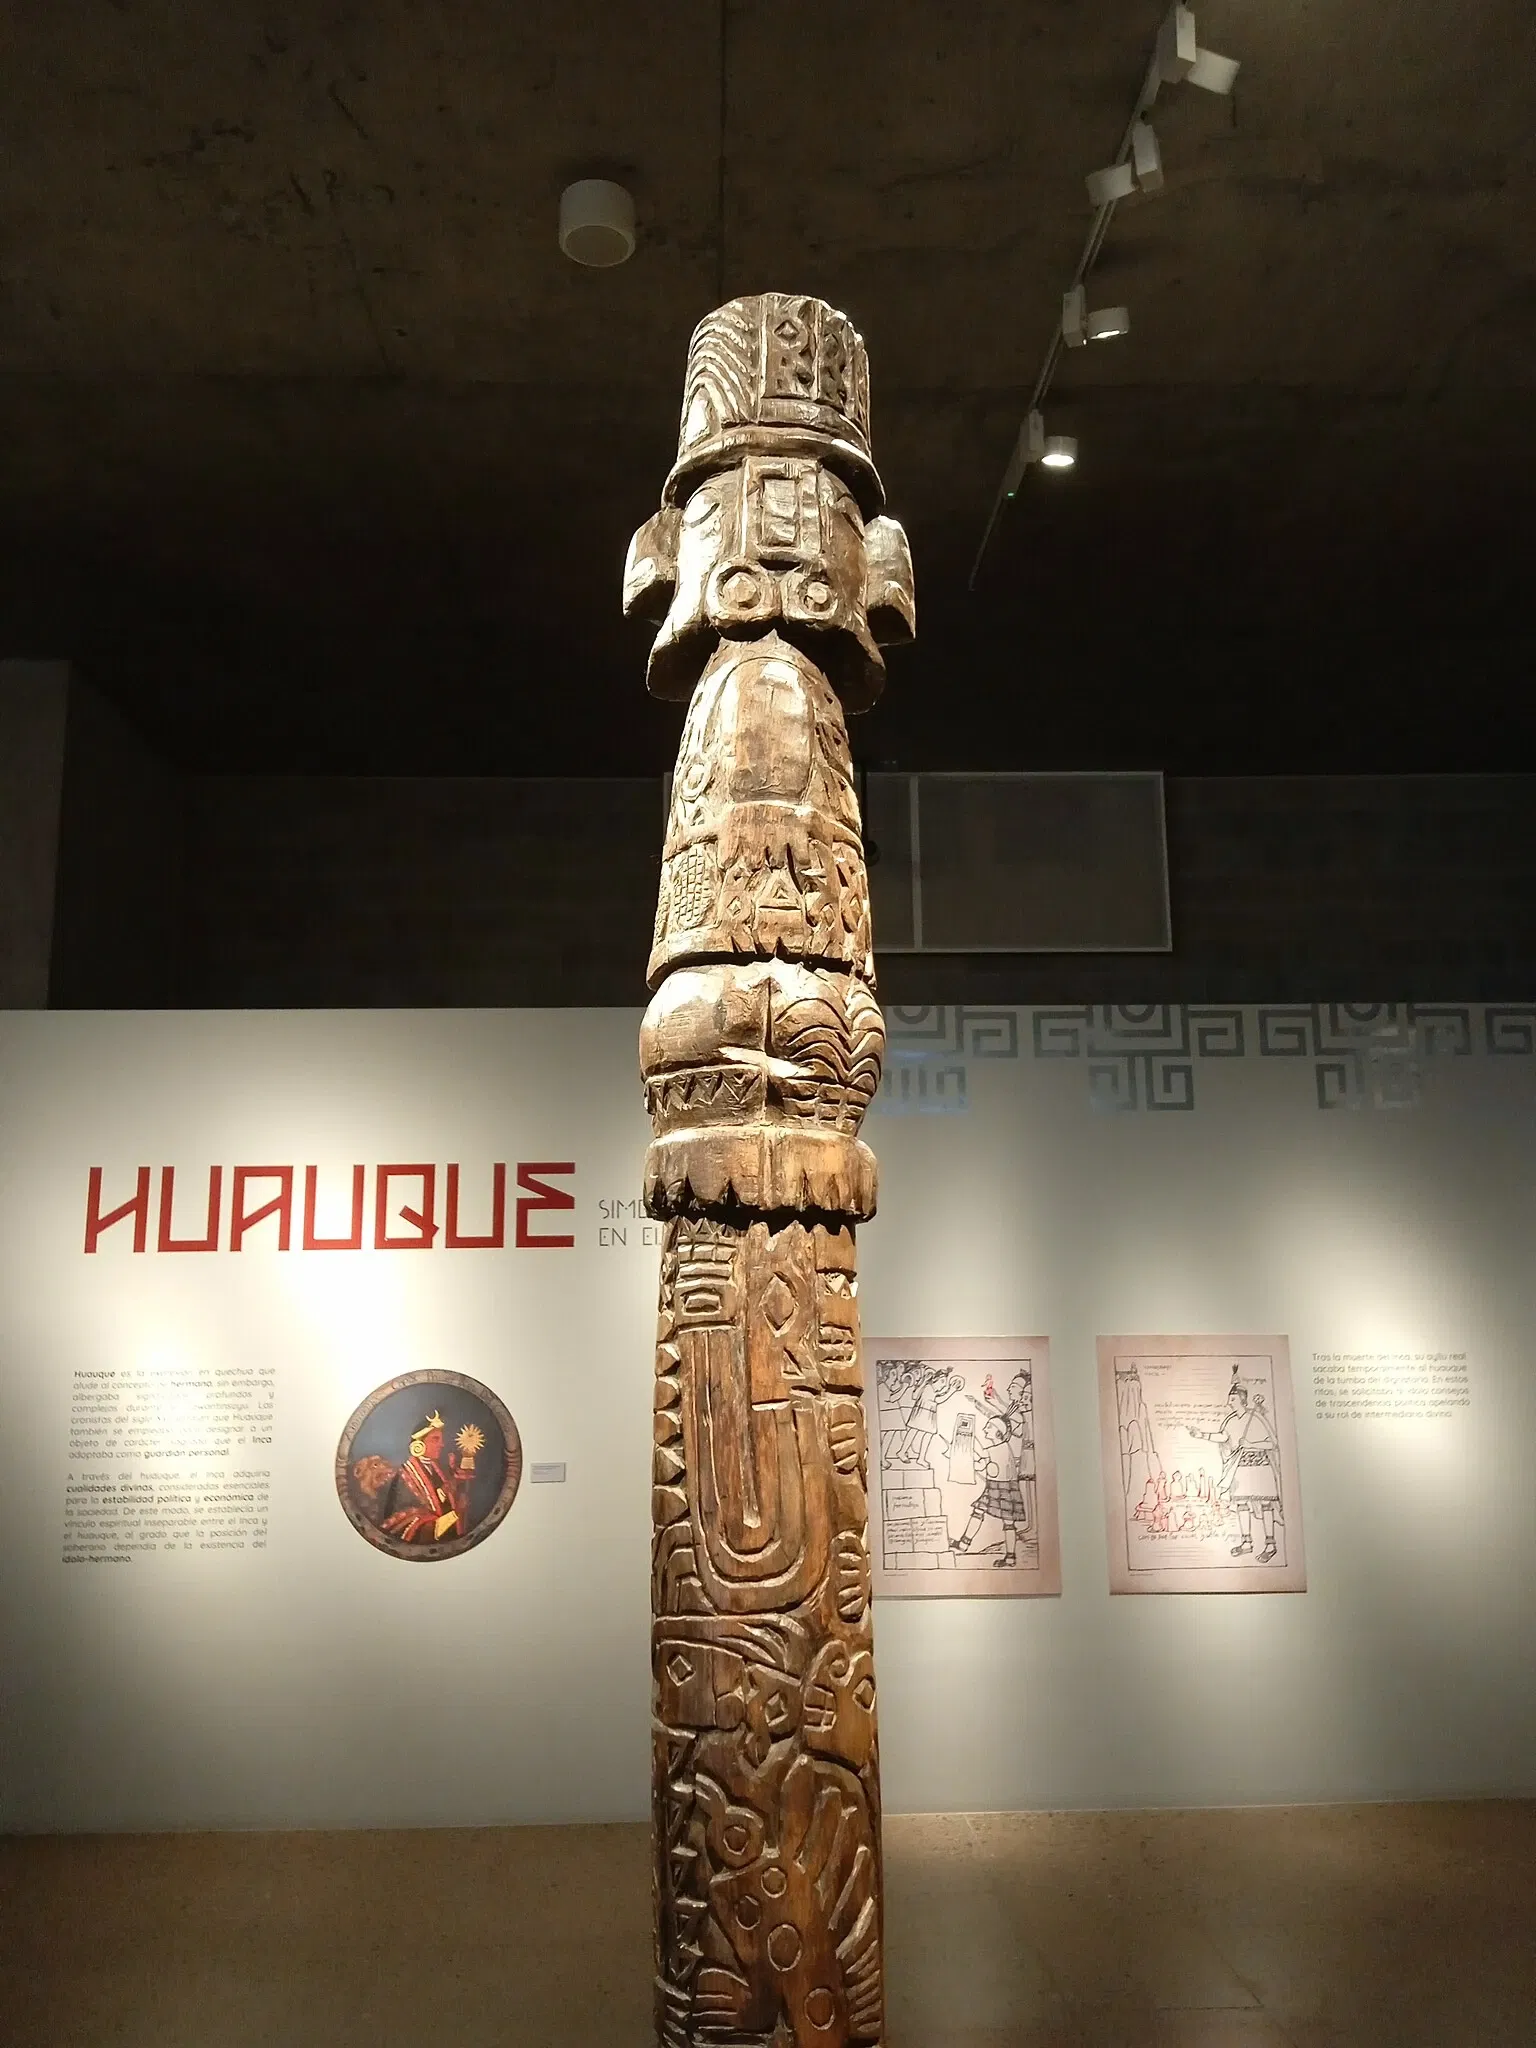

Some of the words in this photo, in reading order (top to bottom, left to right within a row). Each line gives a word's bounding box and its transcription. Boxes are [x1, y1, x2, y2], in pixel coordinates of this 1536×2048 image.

[84, 1162, 576, 1253] HUAUQUE
[599, 1227, 627, 1247] EN
[1312, 1353, 1331, 1361] Tras
[1332, 1353, 1341, 1361] la
[1449, 1353, 1468, 1361] real
[74, 1370, 116, 1379] Huauque
[214, 1368, 254, 1377] quechua
[258, 1367, 276, 1376] que
[1312, 1365, 1345, 1373] sacaba
[73, 1382, 98, 1390] alude
[1313, 1377, 1325, 1385] de
[1326, 1376, 1336, 1385] la
[1432, 1376, 1444, 1384] En
[1446, 1376, 1470, 1384] estos
[72, 1393, 119, 1402] albergaba
[268, 1391, 275, 1399] y
[1431, 1387, 1470, 1397] consejos
[258, 1401, 274, 1409] Los
[1315, 1400, 1327, 1408] de
[71, 1415, 112, 1424] cronistas
[114, 1416, 129, 1424] del
[212, 1414, 230, 1422] que
[232, 1412, 274, 1421] Huauque
[1316, 1412, 1323, 1420] a
[1336, 1411, 1349, 1419] rol
[1350, 1411, 1362, 1419] de
[261, 1424, 273, 1432] un
[69, 1439, 99, 1449] objeto
[105, 1439, 117, 1447] de
[213, 1438, 231, 1446] que
[237, 1436, 246, 1444] el
[252, 1435, 272, 1444] Inca
[68, 1451, 113, 1460] adoptaba
[116, 1451, 141, 1459] como
[82, 1472, 110, 1480] través
[117, 1472, 132, 1480] del
[66, 1484, 117, 1492] cualidades
[158, 1483, 219, 1491] consideradas
[223, 1481, 270, 1490] esenciales
[65, 1497, 88, 1505] para
[91, 1496, 99, 1504] la
[102, 1495, 154, 1504] estabilidad
[194, 1496, 200, 1504] y
[257, 1493, 269, 1501] de
[65, 1508, 74, 1516] la
[123, 1507, 136, 1515] De
[139, 1507, 158, 1515] este
[256, 1505, 269, 1513] un
[99, 1518, 142, 1529] espiritual
[200, 1517, 225, 1526] entre
[227, 1517, 236, 1525] el
[262, 1518, 268, 1526] y
[64, 1532, 72, 1540] el
[124, 1531, 133, 1539] al
[139, 1530, 168, 1540] grado
[172, 1531, 190, 1539] que
[196, 1530, 205, 1538] la
[252, 1528, 268, 1537] del
[62, 1543, 107, 1551] soberano
[163, 1542, 176, 1550] de
[184, 1541, 193, 1550] la
[200, 1540, 245, 1549] existencia
[252, 1540, 267, 1549] del
